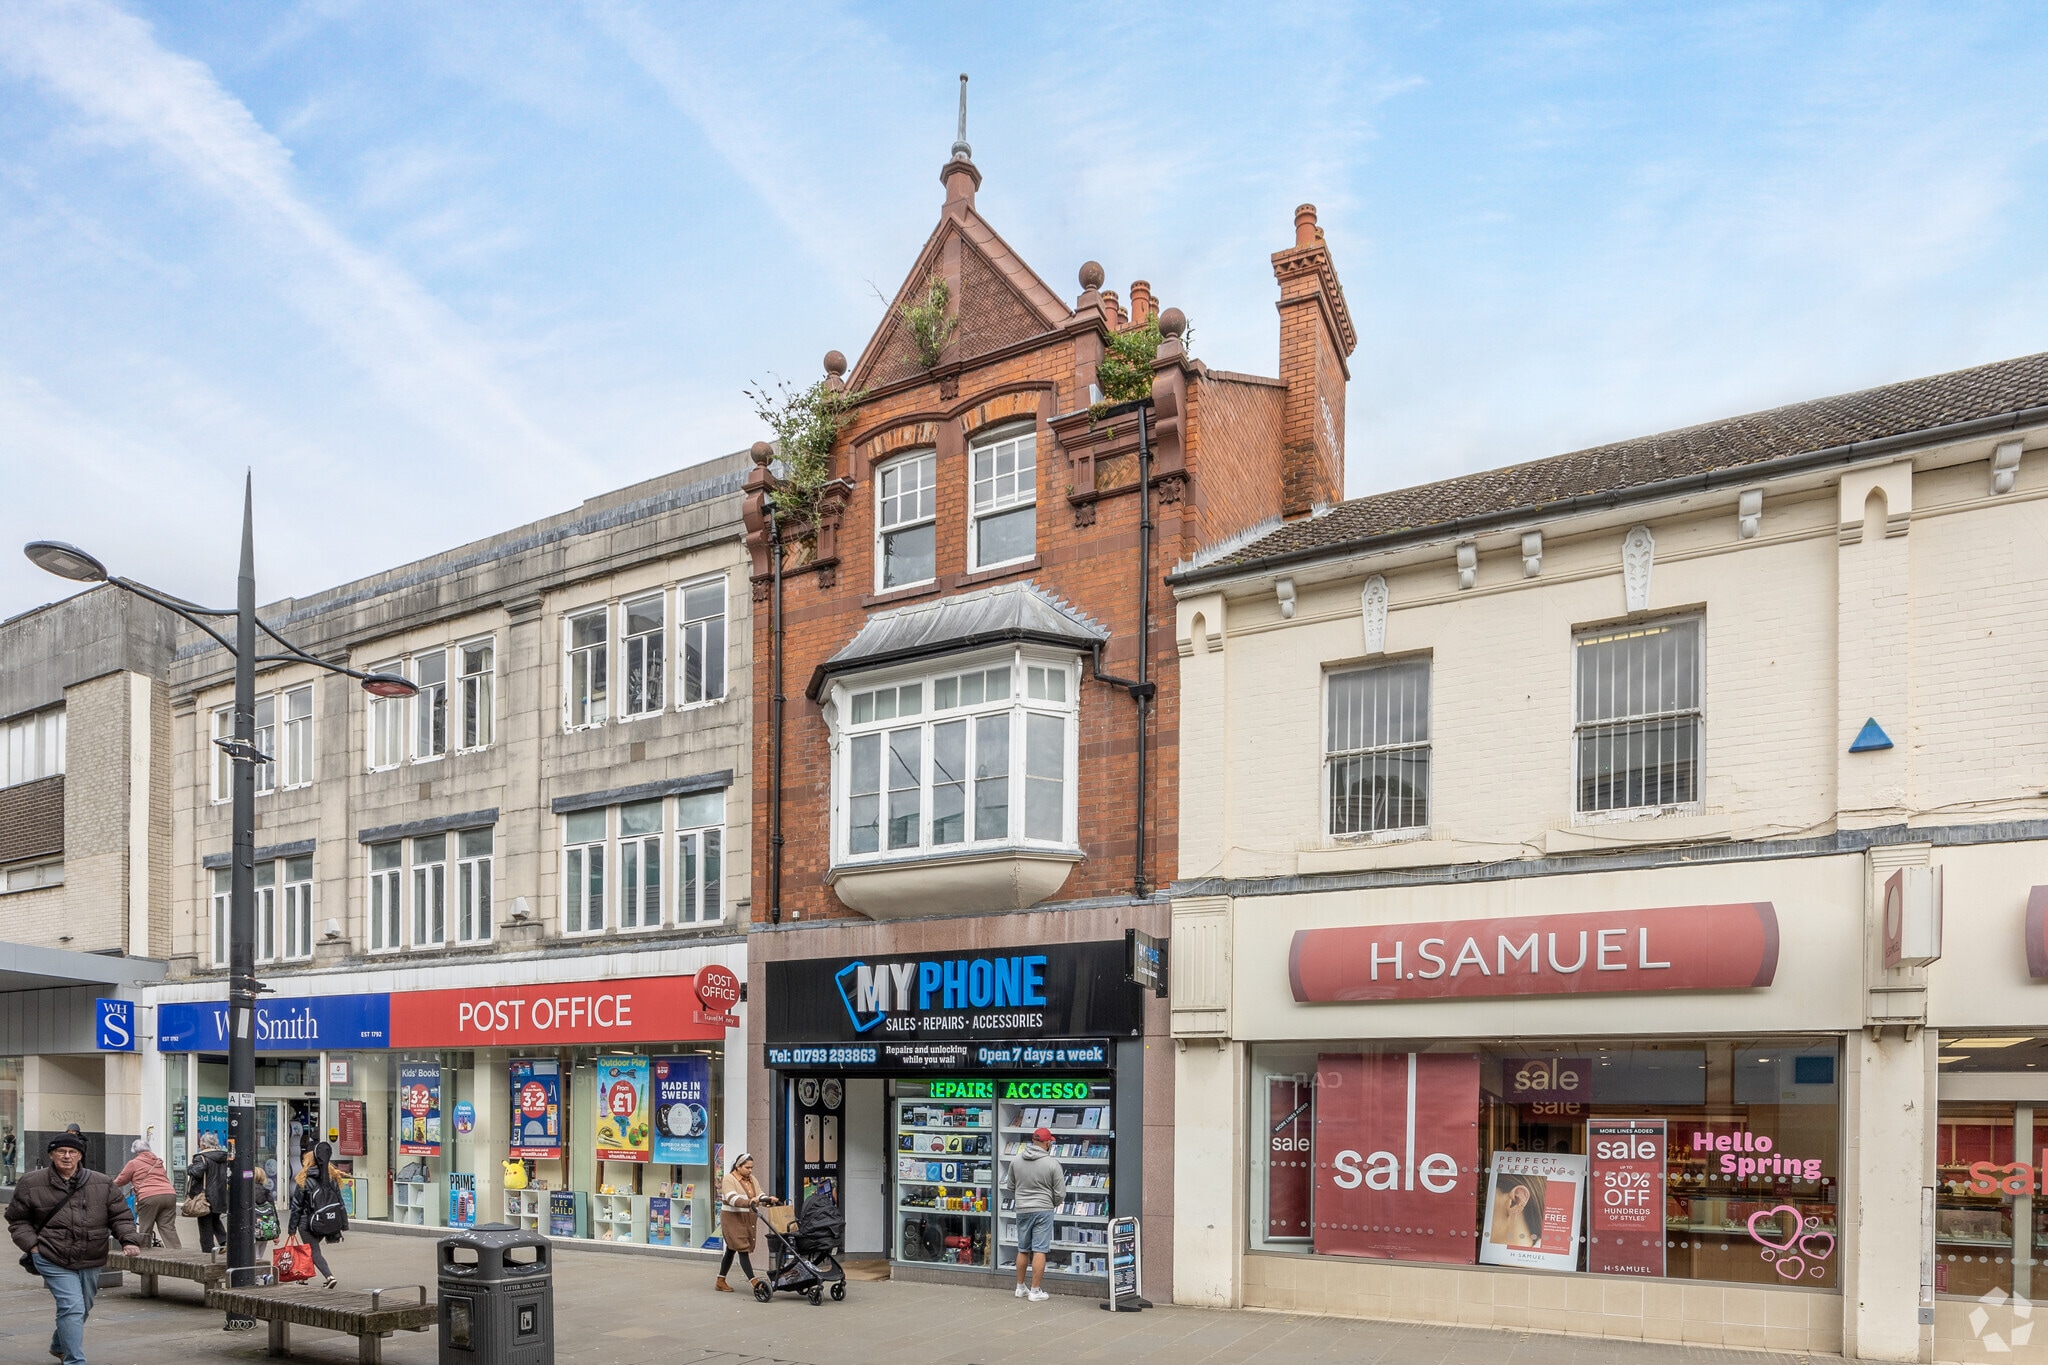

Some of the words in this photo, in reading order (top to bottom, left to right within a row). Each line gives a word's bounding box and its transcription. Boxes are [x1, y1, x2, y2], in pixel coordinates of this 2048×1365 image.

[1370, 927, 1671, 981] H.SAMUEL
[708, 973, 732, 987] POST
[702, 985, 735, 1000] OFFICE
[104, 1002, 128, 1014] WH
[459, 1000, 526, 1032] POST
[532, 994, 632, 1028] OFFICE
[104, 1013, 130, 1047] S
[214, 1008, 318, 1041] WSmith
[886, 1018, 916, 1032] SALES
[923, 1016, 964, 1030] REPAIRS
[972, 1013, 1043, 1029] ACCESSORIES
[770, 1049, 791, 1064] Tel:
[793, 1049, 827, 1062] 01793
[829, 1049, 876, 1062] 293863
[886, 1046, 913, 1054] Repairs
[930, 1046, 967, 1054] unlocking
[979, 1048, 1010, 1064] Open
[1012, 1047, 1022, 1062] 7
[1024, 1047, 1054, 1064] days
[1056, 1050, 1065, 1061] a
[1067, 1047, 1103, 1061] week
[632, 1059, 646, 1067] Play
[402, 1069, 417, 1078] Kids'
[418, 1069, 440, 1077] Books
[1515, 1058, 1579, 1090] sale
[662, 1082, 688, 1090] MADE
[690, 1082, 700, 1090] IN
[1006, 1082, 1088, 1099] ACCESSO
[411, 1090, 418, 1104] 3
[422, 1090, 429, 1104] 2
[523, 1092, 531, 1107] 3
[536, 1092, 545, 1106] 2
[613, 1093, 632, 1112] £1
[662, 1091, 700, 1099] SWEDEN
[1275, 1122, 1287, 1132] MORE
[1286, 1112, 1297, 1123] LINES
[1296, 1102, 1308, 1114] ADDED
[1693, 1132, 1772, 1152] Hello
[1500, 1156, 1557, 1164] PERFECT
[1720, 1153, 1822, 1180] Spring
[1970, 1148, 2048, 1195] sal
[450, 1175, 475, 1191] PRIME
[1604, 1172, 1650, 1188] 50%
[1604, 1189, 1650, 1206] OFF
[550, 1206, 574, 1215] CHILD
[1545, 1214, 1567, 1222] FREE
